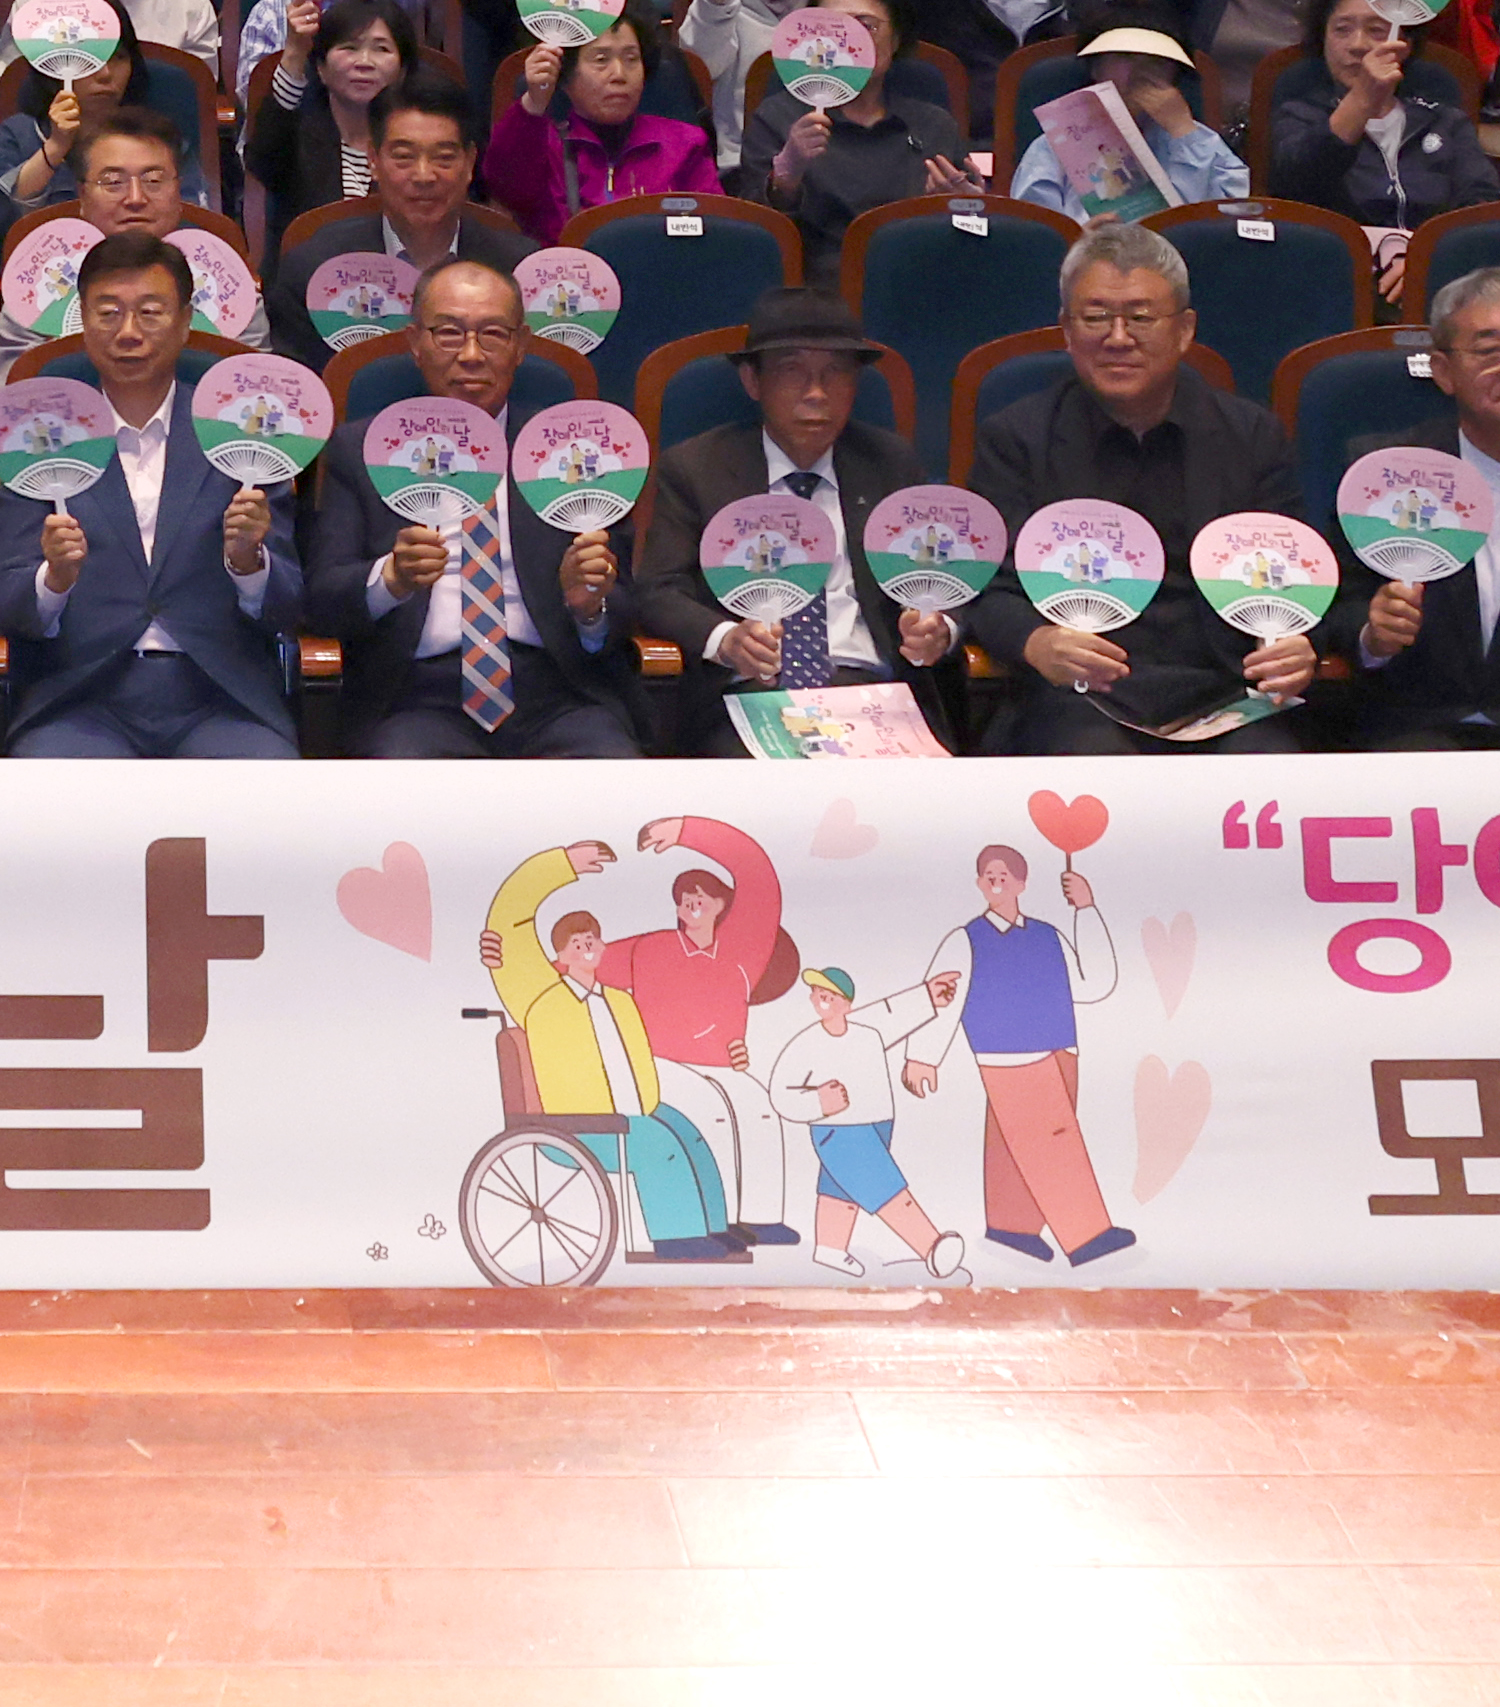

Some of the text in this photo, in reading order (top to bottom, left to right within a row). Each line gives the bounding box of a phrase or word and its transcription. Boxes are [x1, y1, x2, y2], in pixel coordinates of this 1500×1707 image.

[74, 7, 90, 23] 날
[382, 275, 398, 295] 날
[577, 271, 590, 290] 날
[399, 417, 448, 437] 장애인의
[450, 424, 470, 448] 날
[542, 422, 610, 448] 장애인의 날
[1435, 476, 1456, 503] 날
[781, 517, 800, 540] 날
[949, 512, 970, 538] 날
[1051, 521, 1125, 553] 장애인의 날
[1280, 537, 1299, 562] 날
